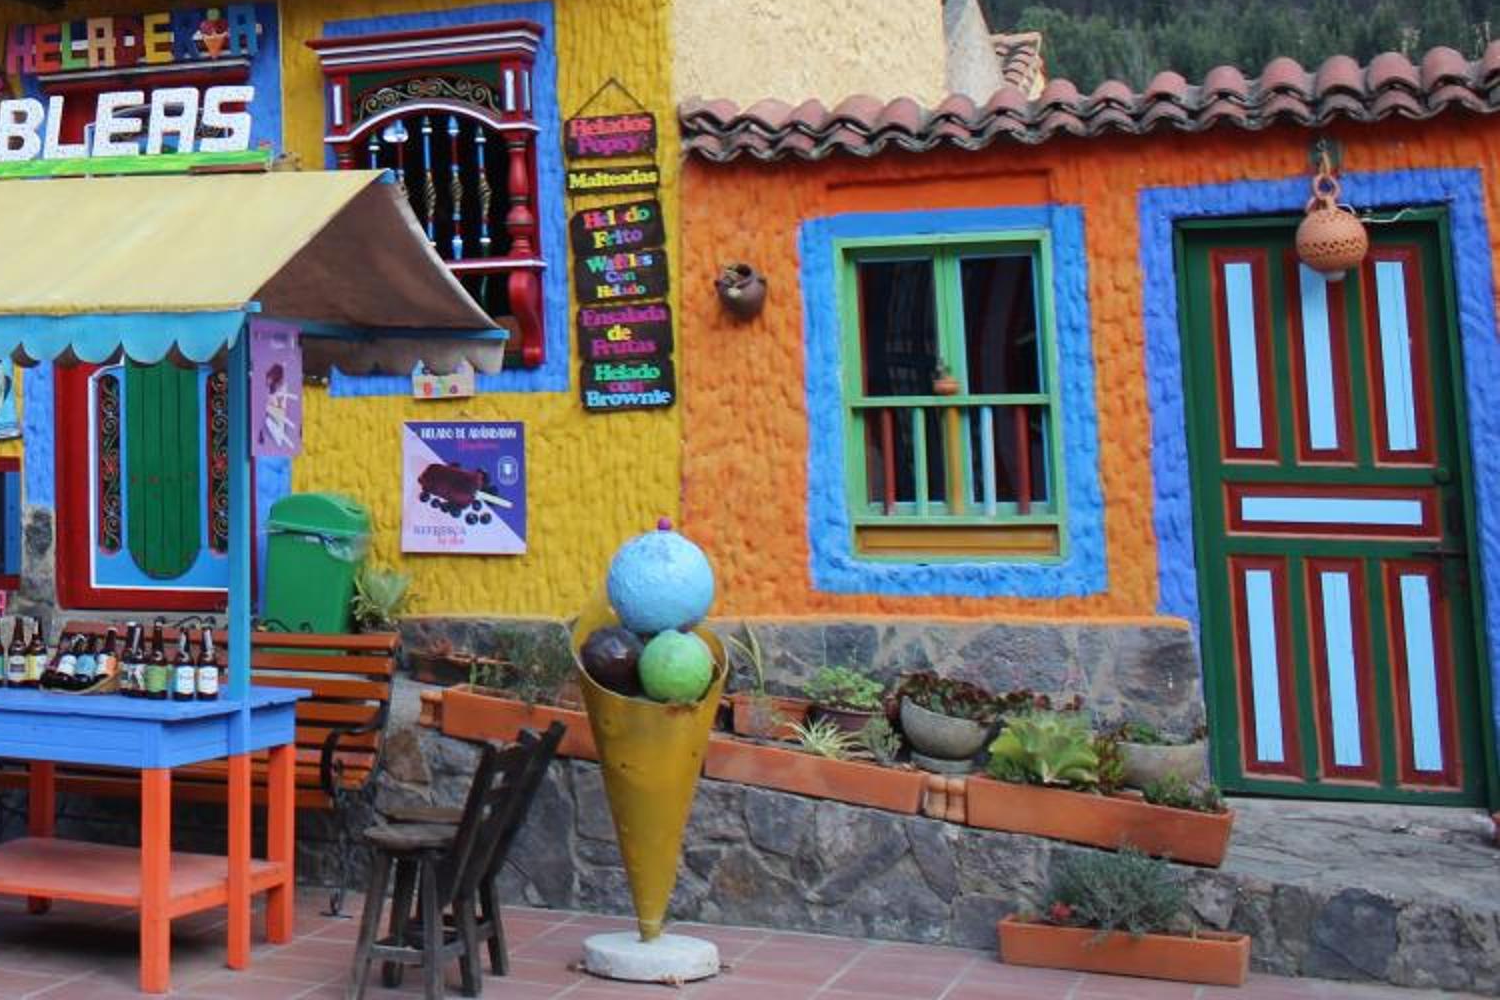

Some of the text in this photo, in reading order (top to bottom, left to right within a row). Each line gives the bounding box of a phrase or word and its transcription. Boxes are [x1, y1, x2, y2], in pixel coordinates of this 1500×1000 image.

[570, 116, 651, 137] Helados
[569, 169, 657, 189] Malteadas
[583, 206, 650, 229] Helado
[593, 227, 643, 249] Frito
[586, 253, 652, 273] Waffles
[596, 284, 646, 298] Helado
[581, 306, 668, 327] Ensalada
[607, 323, 632, 341] de
[592, 338, 656, 356] Frutas
[595, 363, 660, 381] Helado
[586, 389, 671, 407] Brownie
